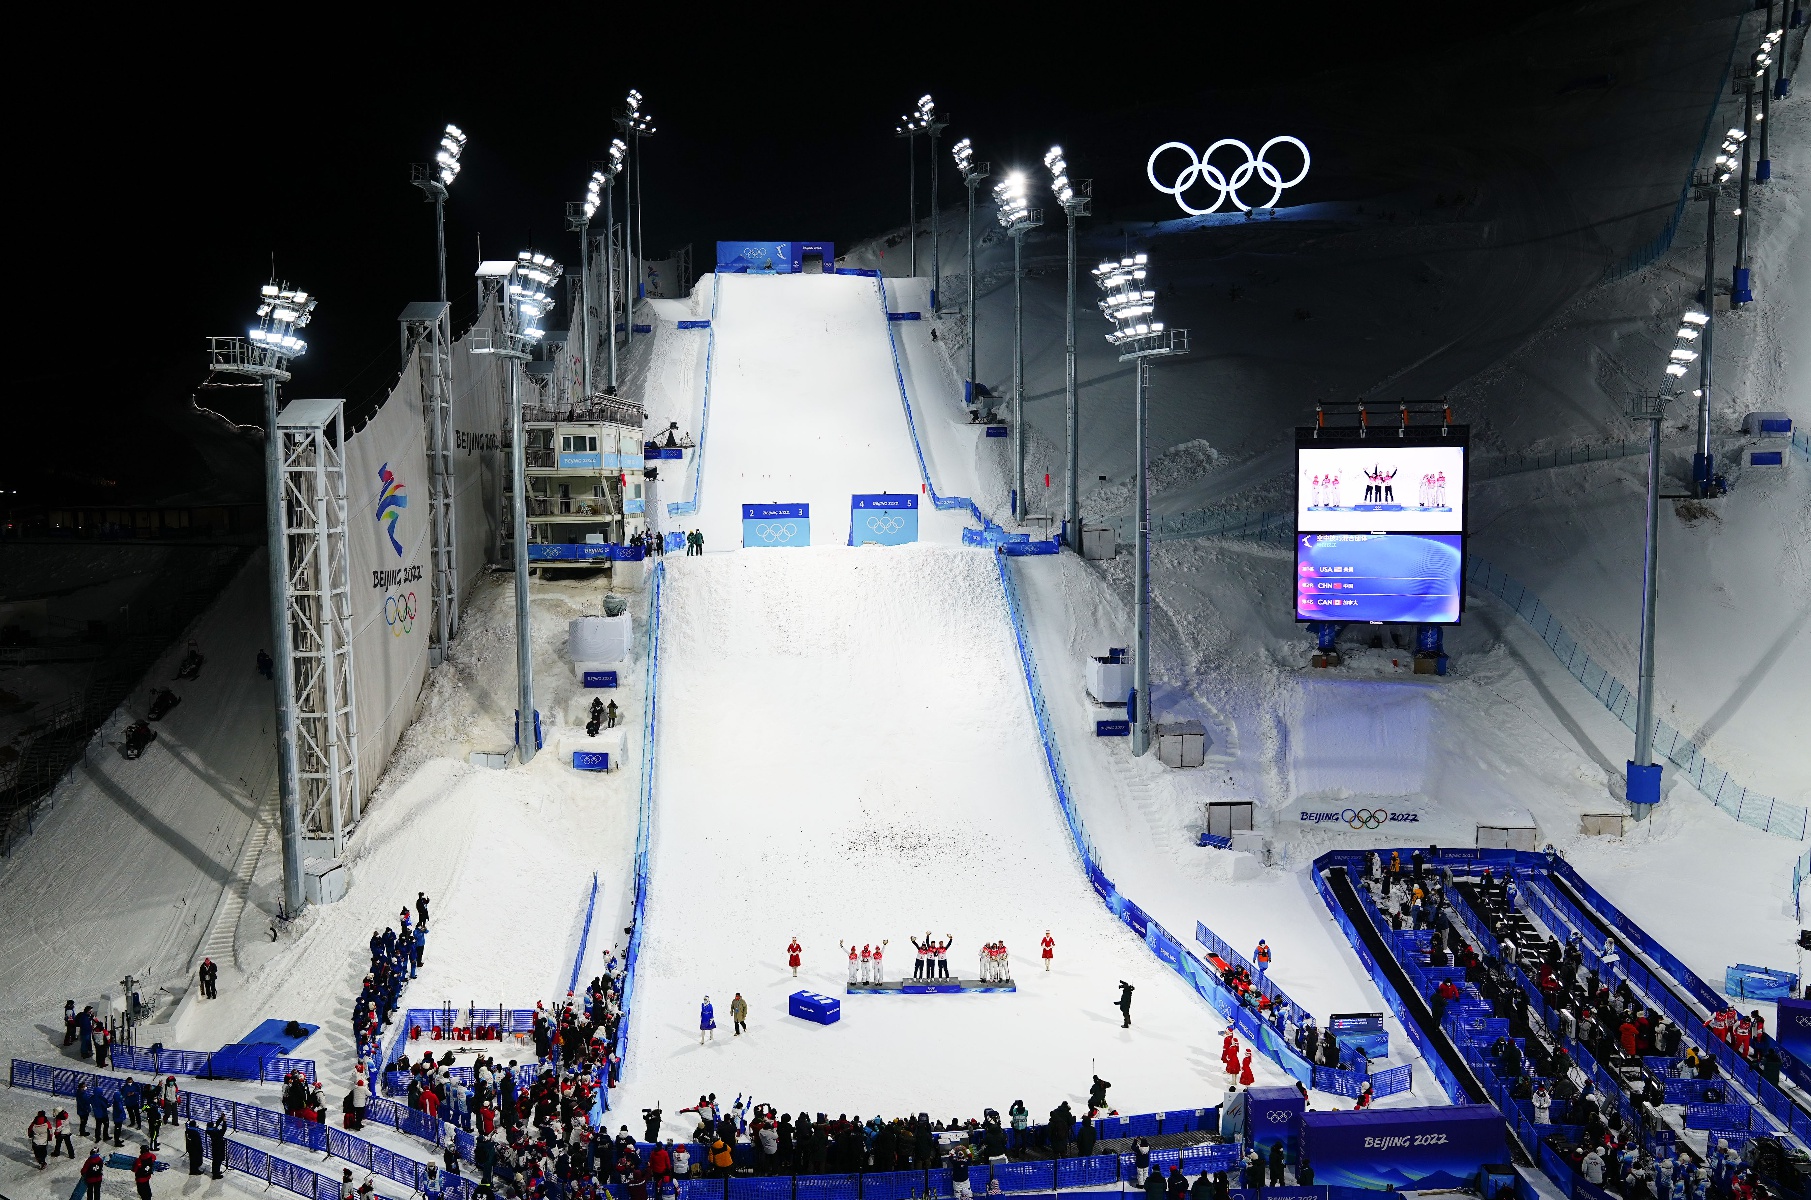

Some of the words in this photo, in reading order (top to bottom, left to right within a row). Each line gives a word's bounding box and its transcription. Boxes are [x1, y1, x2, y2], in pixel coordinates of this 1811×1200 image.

[455, 430, 484, 456] BEIJING
[859, 500, 865, 508] 4
[907, 499, 912, 507] 5
[749, 509, 754, 517] 2
[798, 508, 803, 516] 3
[372, 569, 402, 592] BEIJING
[403, 565, 423, 584] 2022
[1300, 811, 1340, 824] BEIJING
[1389, 812, 1420, 823] 2022
[1364, 1135, 1411, 1151] BEIJING
[1413, 1133, 1449, 1146] 2022
